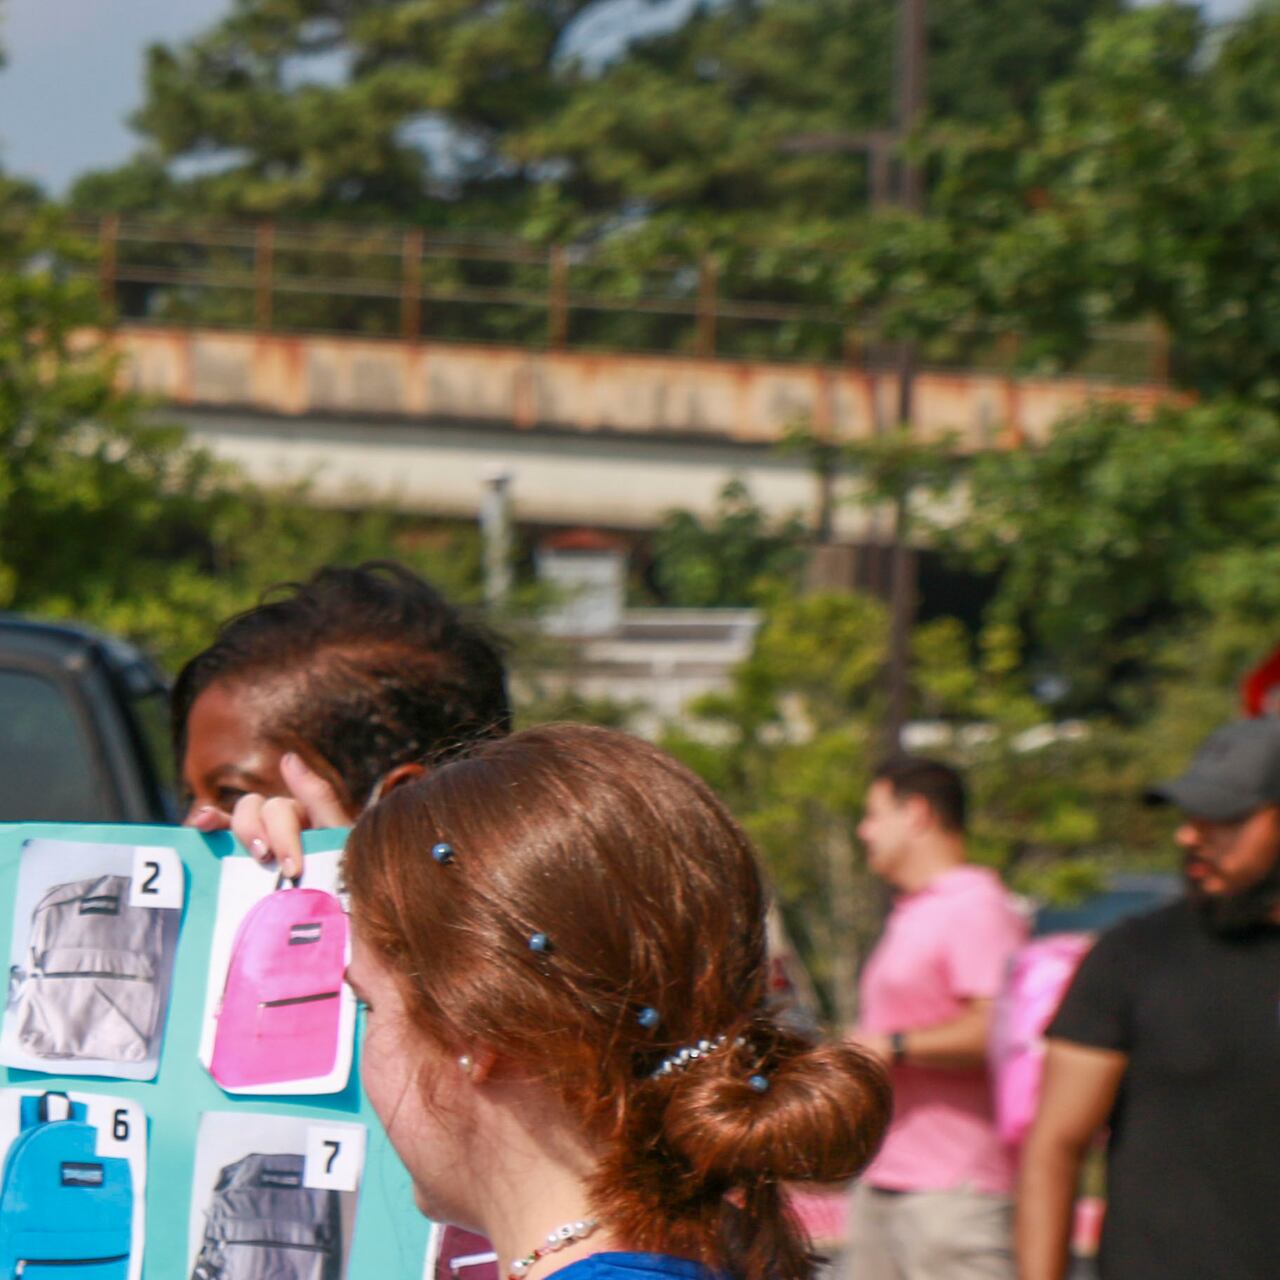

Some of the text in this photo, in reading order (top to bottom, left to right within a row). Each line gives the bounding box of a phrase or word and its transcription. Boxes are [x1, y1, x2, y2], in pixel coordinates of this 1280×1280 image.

[141, 861, 161, 895] 2
[112, 1108, 130, 1142] 6
[323, 1140, 341, 1174] 7
